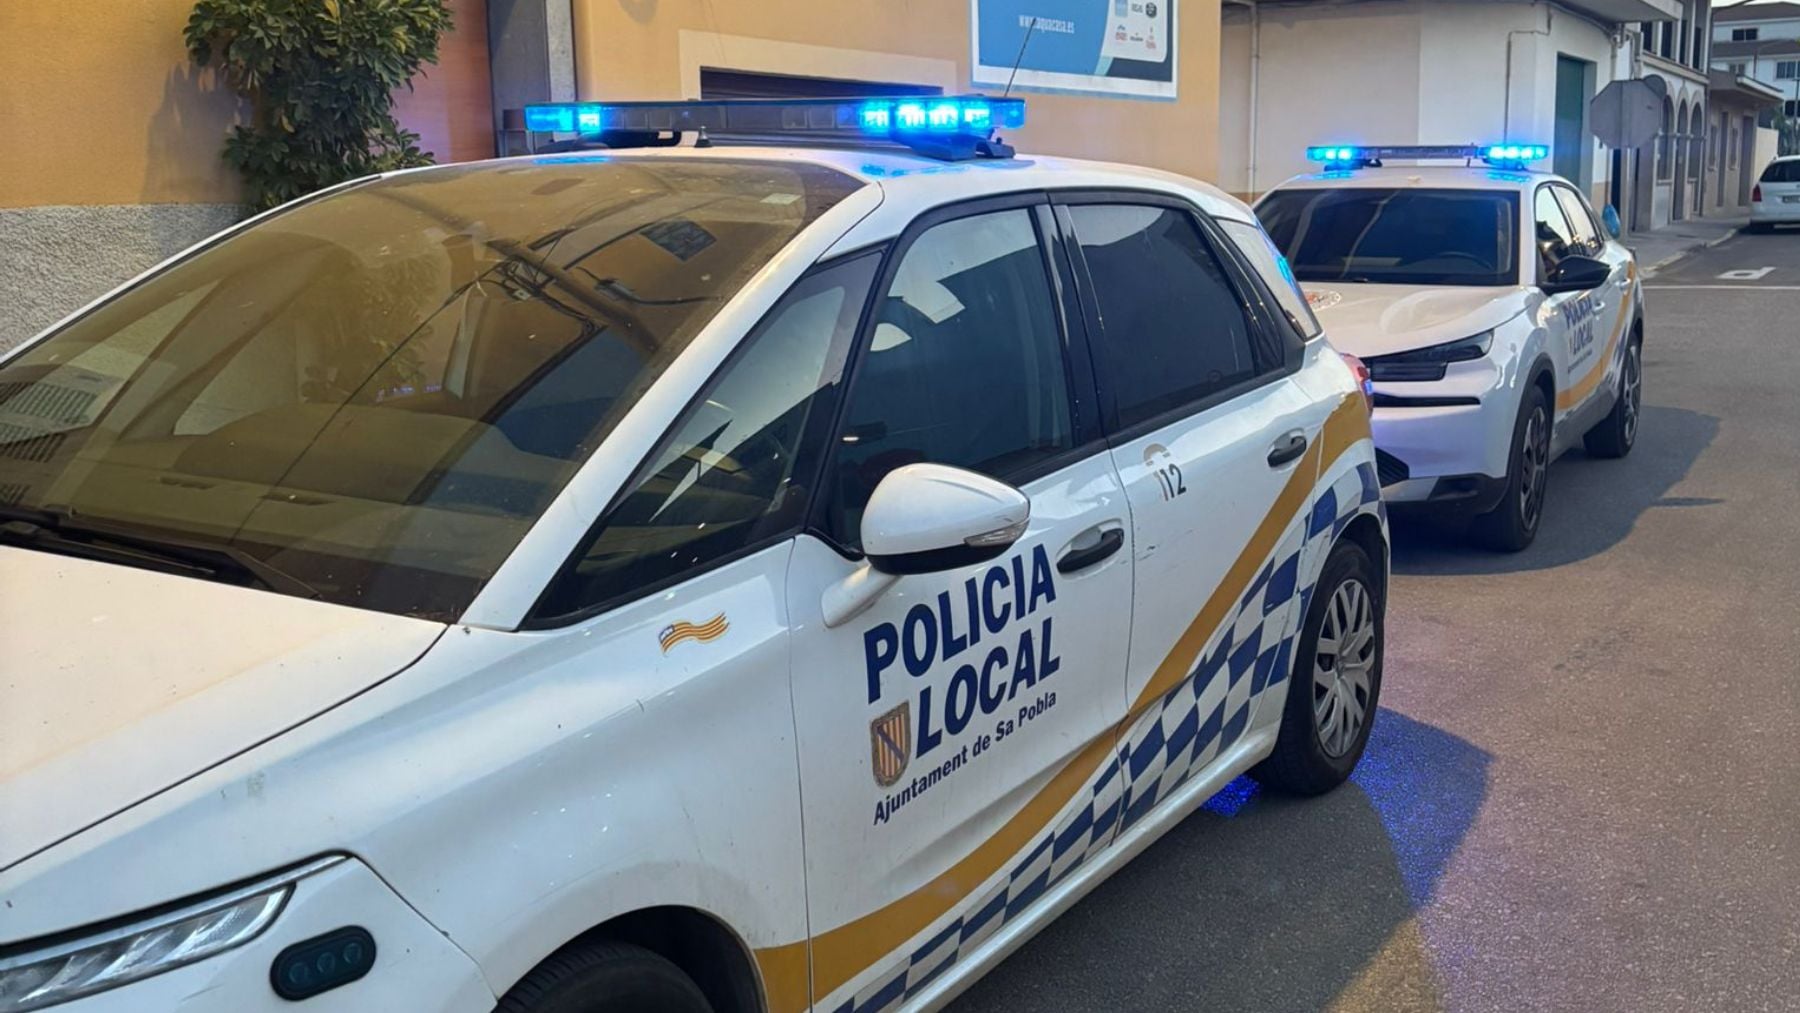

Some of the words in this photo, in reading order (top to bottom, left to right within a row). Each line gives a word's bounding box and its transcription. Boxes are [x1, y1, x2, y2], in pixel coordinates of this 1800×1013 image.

[1153, 463, 1187, 502] 112
[864, 544, 1057, 704] POLICIA
[915, 616, 1061, 760] LOCAL
[873, 745, 969, 826] Ajuntament
[972, 734, 992, 758] de
[995, 718, 1015, 743] Sa
[1018, 691, 1057, 728] Pobla
